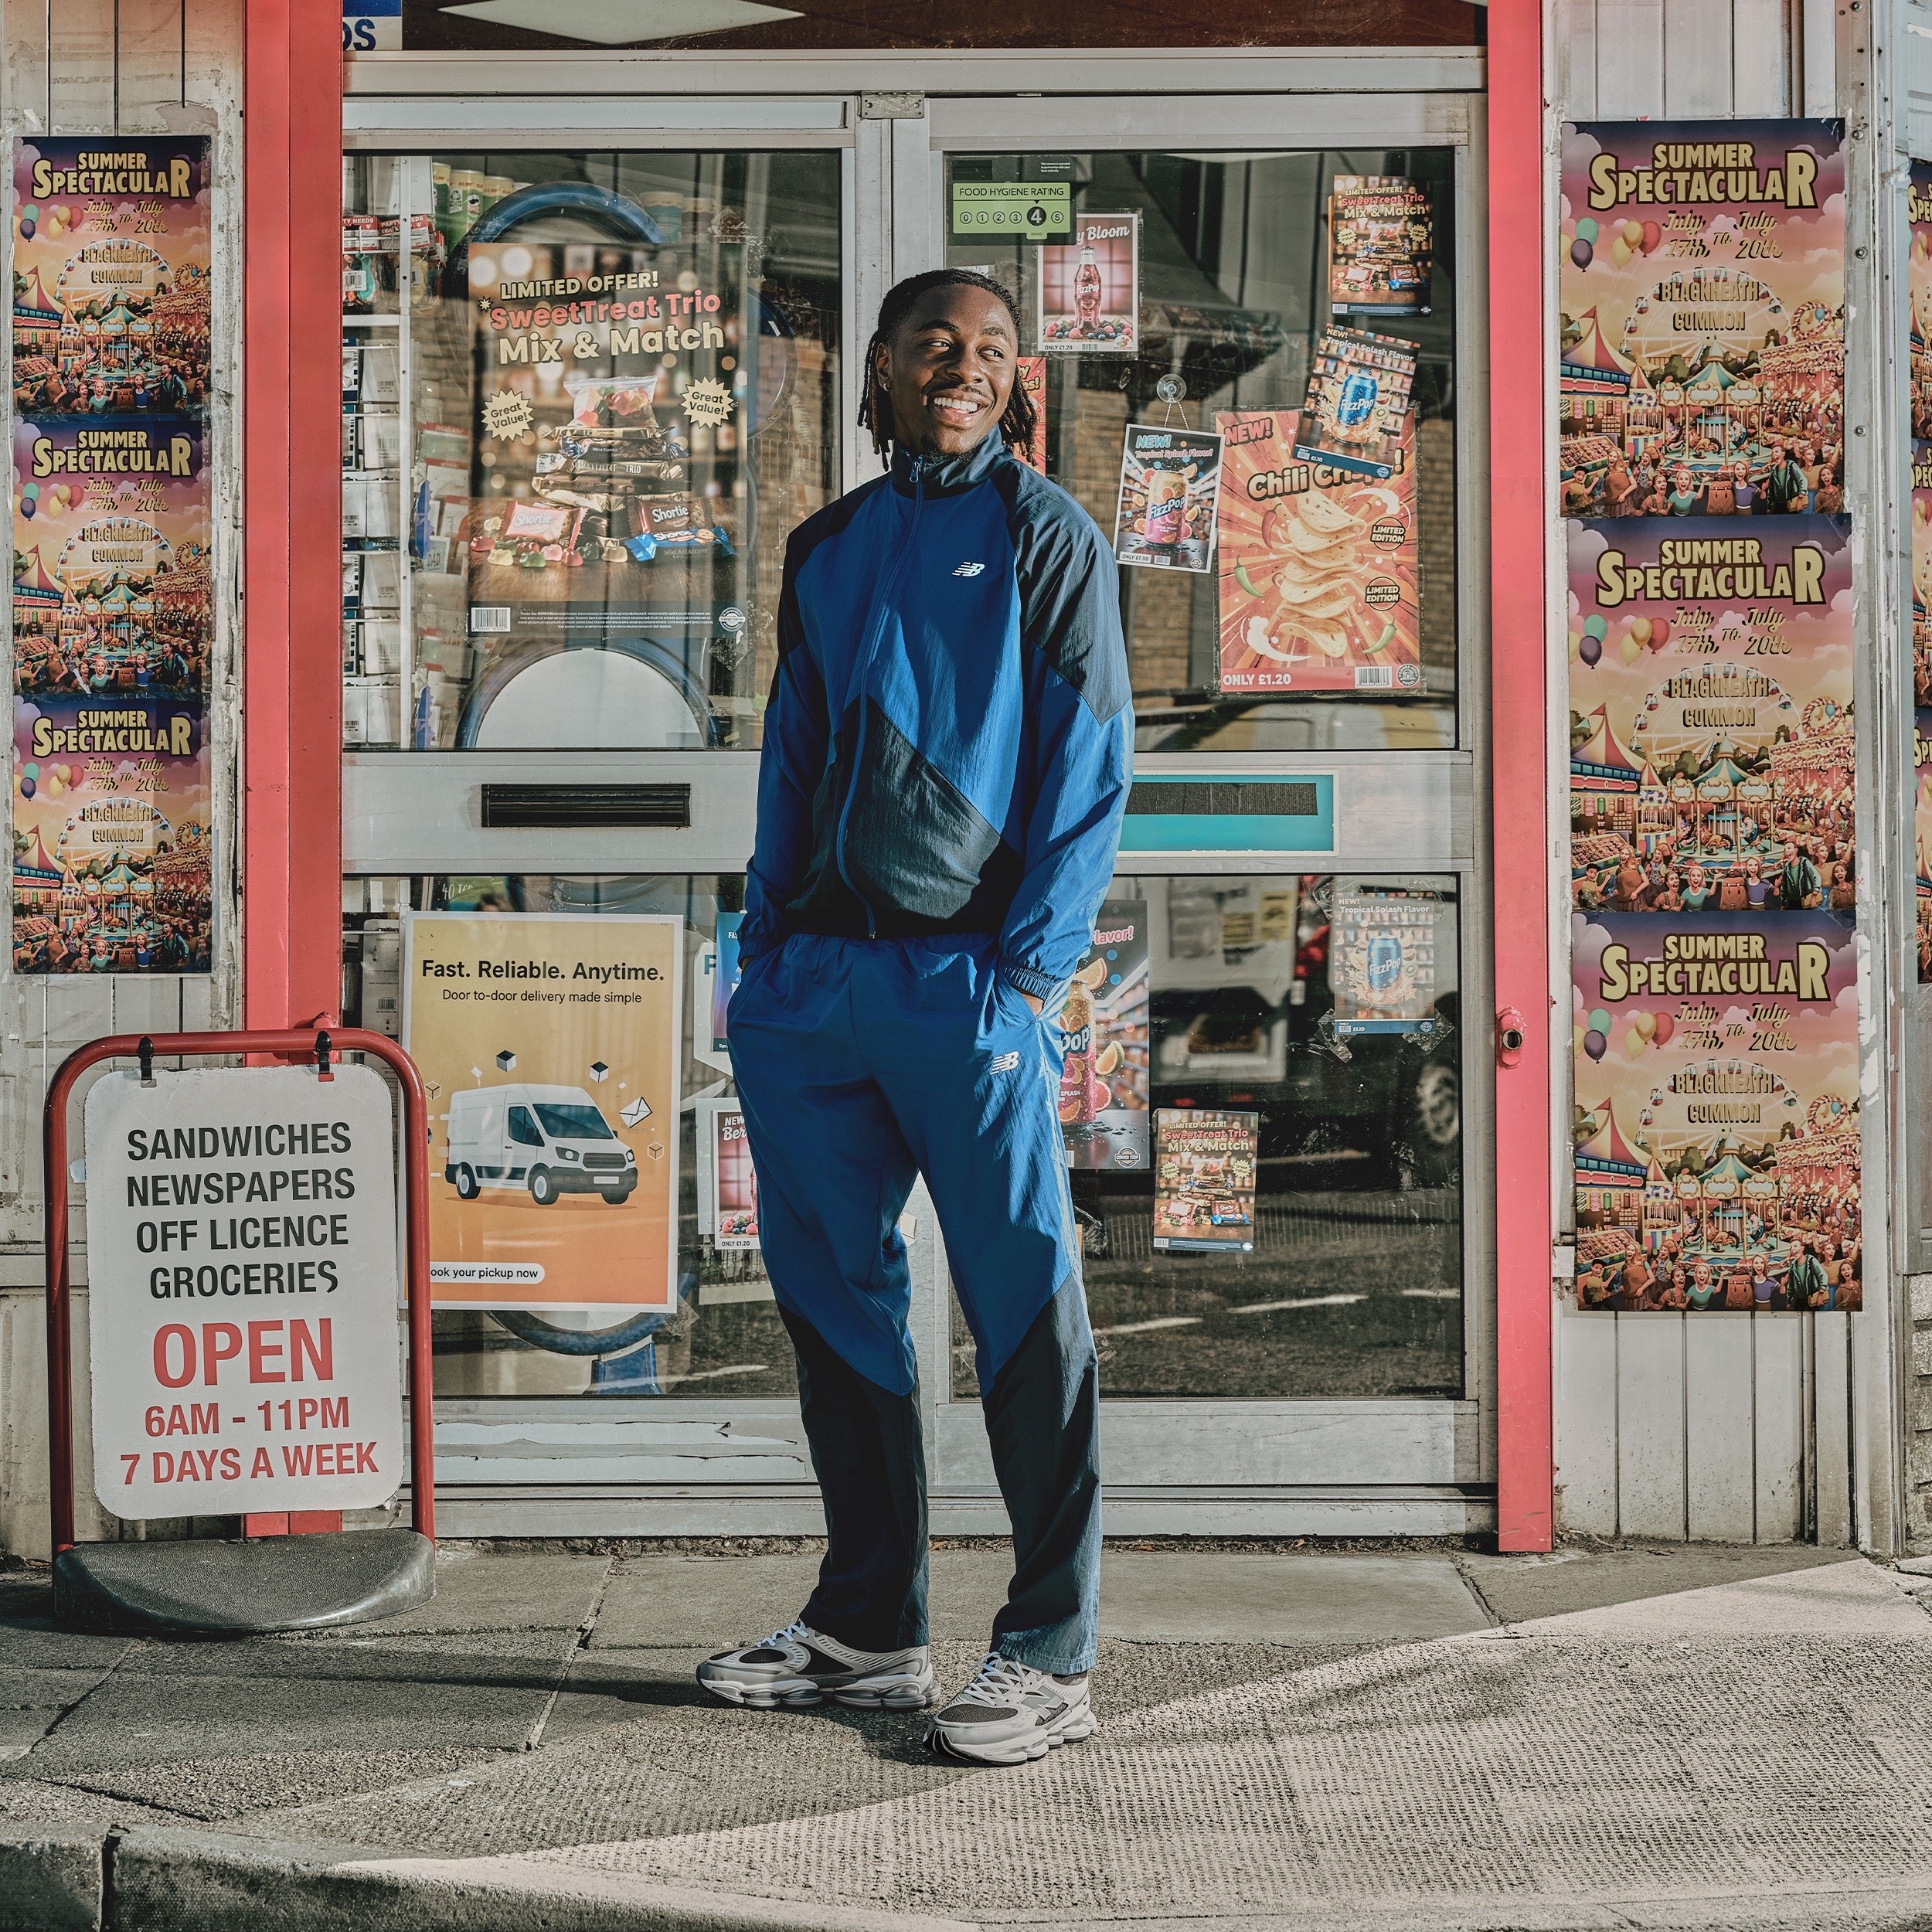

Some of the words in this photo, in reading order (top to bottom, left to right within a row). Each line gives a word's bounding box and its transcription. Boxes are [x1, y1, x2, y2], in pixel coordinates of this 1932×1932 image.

[78, 153, 147, 170] SUMMER
[1654, 144, 1753, 169] SUMMER
[33, 159, 191, 199] SPECTACULAR
[1588, 151, 1818, 210] SPECTACULAR
[959, 188, 987, 196] FOOD
[989, 188, 1029, 196] HYGIENE
[1031, 188, 1064, 196] RATING
[1342, 195, 1402, 207] SweetTreat
[1404, 193, 1424, 202] Trio
[1344, 208, 1367, 219] Mix
[1371, 207, 1380, 217] &
[1384, 205, 1425, 216] Match
[1662, 209, 1706, 236] July
[1733, 210, 1777, 236] July
[1087, 226, 1130, 240] Bloom
[82, 249, 152, 264] BLACKHEATH
[1734, 239, 1783, 260] 20th
[91, 270, 142, 284] COMMON
[500, 277, 581, 301] LIMITED
[587, 270, 659, 292] OFFER!
[1658, 282, 1760, 301] BLACKHEATH
[490, 296, 658, 330] SweetTreat
[665, 289, 721, 316] Trio
[1672, 311, 1746, 332] COMMON
[1326, 328, 1349, 338] NEW!
[499, 332, 563, 365] Mix
[573, 331, 599, 359] &
[610, 321, 724, 356] Match
[1326, 337, 1359, 350] Tropical
[1360, 344, 1387, 356] Splash
[1389, 350, 1414, 362] Flavor
[692, 390, 724, 405] Great
[1340, 398, 1375, 411] FizzPop
[490, 402, 522, 419] Great
[689, 401, 725, 417] Value!
[492, 413, 529, 430] Value!
[78, 431, 148, 448] SUMMER
[1135, 434, 1172, 448] NEW!
[1223, 417, 1273, 447] NEW!
[33, 437, 192, 477] SPECTACULAR
[1135, 450, 1163, 459] Tropical
[1164, 449, 1188, 457] Splash
[1189, 448, 1213, 457] Flavor!
[624, 464, 641, 474] TRIO
[1247, 464, 1310, 501] Chili
[652, 505, 689, 523] Shortie
[1149, 495, 1186, 520] FizzPop
[82, 528, 153, 542] BLACKHEATH
[1372, 526, 1405, 535] LIMITED
[1372, 534, 1404, 543] EDITION
[92, 548, 143, 562] COMMON
[427, 553, 440, 567] DAD
[1662, 539, 1760, 566] SUMMER
[1597, 547, 1825, 606] SPECTACULAR
[1366, 585, 1400, 594] LIMITED
[1366, 594, 1400, 603] EDITION
[1670, 606, 1714, 631] July
[1741, 607, 1785, 633] July
[1743, 635, 1792, 656] 20th
[1223, 674, 1254, 686] ONLY
[1257, 674, 1292, 686] £1.20
[1668, 678, 1770, 699] BLACKHEATH
[78, 710, 147, 728] SUMMER
[1682, 707, 1756, 728] COMMON
[33, 717, 192, 757] SPECTACULAR
[82, 808, 153, 822] BLACKHEATH
[92, 828, 144, 842] COMMON
[442, 883, 454, 900] 40
[1340, 906, 1373, 915] Tropical
[1375, 906, 1403, 915] Splash
[1091, 925, 1134, 946] lavor!
[1665, 935, 1765, 961] SUMMER
[422, 959, 471, 978] Fast.
[478, 960, 566, 980] Reliable.
[572, 961, 665, 984] Anytime.
[1369, 957, 1402, 976] FizzPop
[1600, 943, 1830, 1002] SPECTACULAR
[443, 989, 471, 1002] Door
[474, 989, 518, 1002] to-door
[520, 990, 566, 1005] delivery
[569, 991, 601, 1003] made
[604, 992, 642, 1005] simple
[1675, 1001, 1719, 1028] July
[1747, 1002, 1790, 1029] July
[1748, 1031, 1797, 1052] 20th
[1673, 1073, 1774, 1094] BLACKHEATH
[1688, 1104, 1760, 1124] COMMON
[127, 1121, 352, 1162] SANDWICHES
[722, 1126, 748, 1141] Ber
[1165, 1130, 1226, 1141] SweetTreat
[1228, 1128, 1248, 1138] Trio
[1168, 1141, 1191, 1152] Mix
[1194, 1141, 1204, 1151] &
[1208, 1140, 1249, 1151] Match
[127, 1167, 355, 1207] NEWSPAPERS
[136, 1219, 198, 1253] OFF
[209, 1214, 349, 1250] LICENCE
[149, 1260, 338, 1299] GROCERIES
[430, 1267, 450, 1280] ook
[453, 1268, 476, 1281] your
[478, 1267, 514, 1281] pickup
[516, 1269, 539, 1280] now
[153, 1318, 334, 1389] OPEN
[145, 1402, 219, 1437] 6AM
[257, 1396, 350, 1432] 11PM
[120, 1454, 141, 1486] 7
[153, 1447, 241, 1484] DAYS
[250, 1447, 275, 1479] A
[281, 1442, 380, 1477] WEEK
